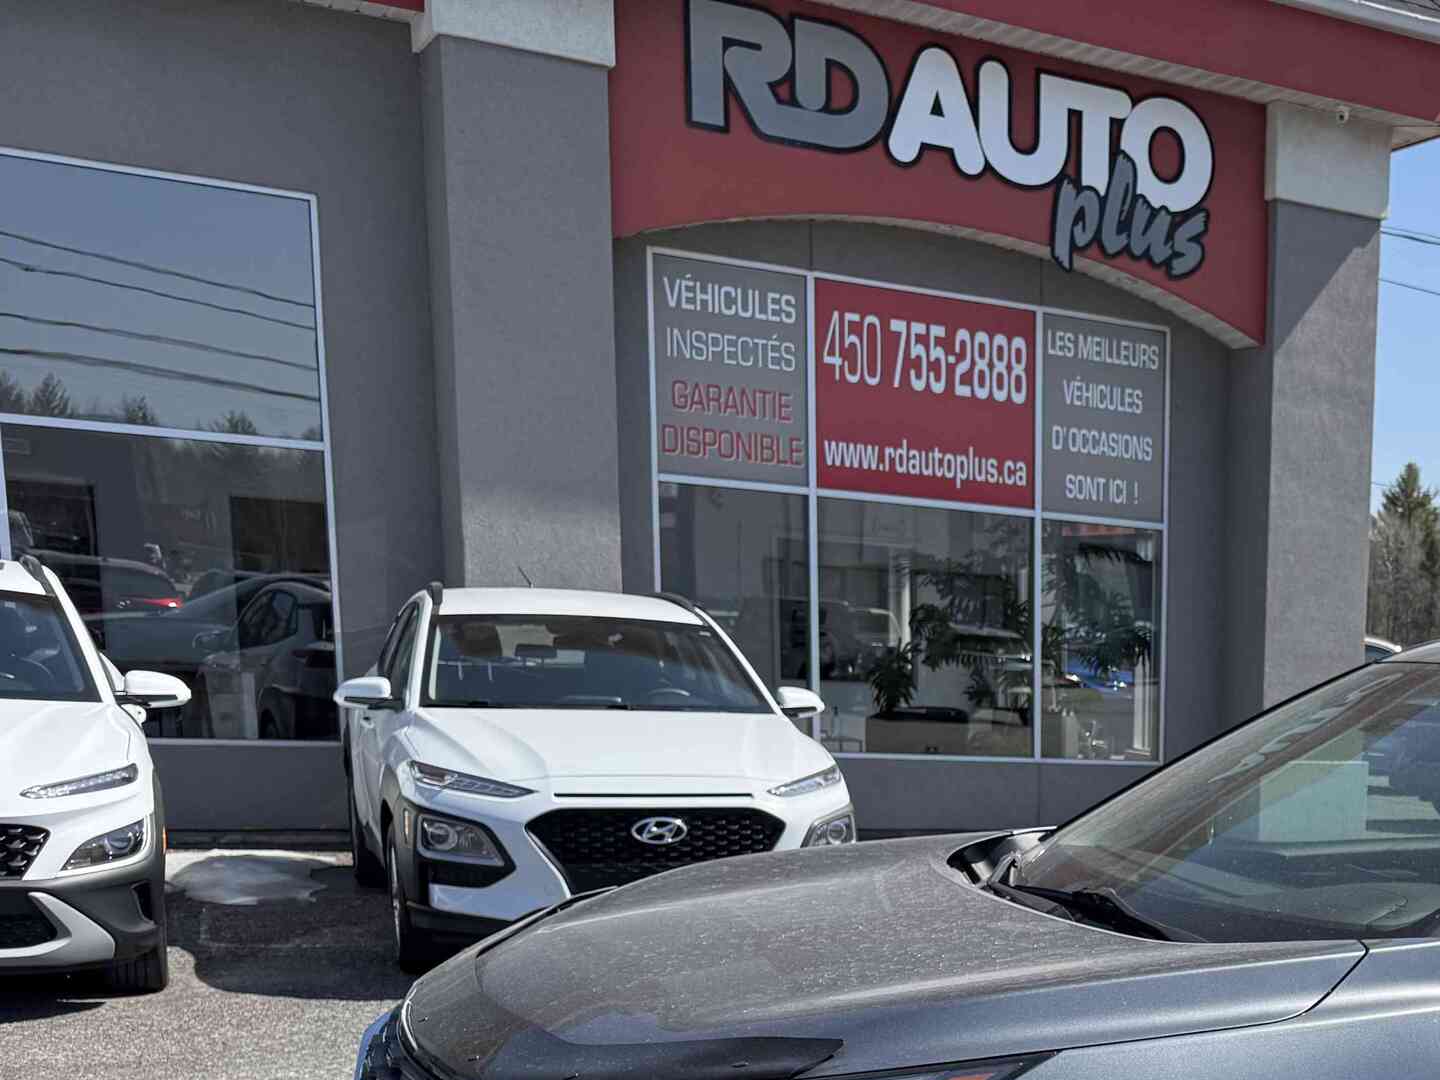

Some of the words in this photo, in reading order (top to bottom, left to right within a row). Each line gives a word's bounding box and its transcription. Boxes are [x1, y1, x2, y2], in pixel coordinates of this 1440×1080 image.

[1051, 150, 1209, 274] plus
[663, 273, 797, 324] VÉHICULES
[666, 327, 796, 372] INSPECTÉS
[823, 310, 882, 386] 450
[889, 318, 1027, 405] 755-2888
[1047, 329, 1075, 358] LES
[1077, 333, 1159, 370] MEILLEURS
[672, 379, 793, 424] GARANTIE
[1063, 376, 1143, 414] VÉHICULES
[661, 424, 806, 467] DISPONIBLE
[824, 439, 1027, 489] www.rdautoplus.ca
[1065, 474, 1106, 502] SONT
[1108, 478, 1127, 504] ICI
